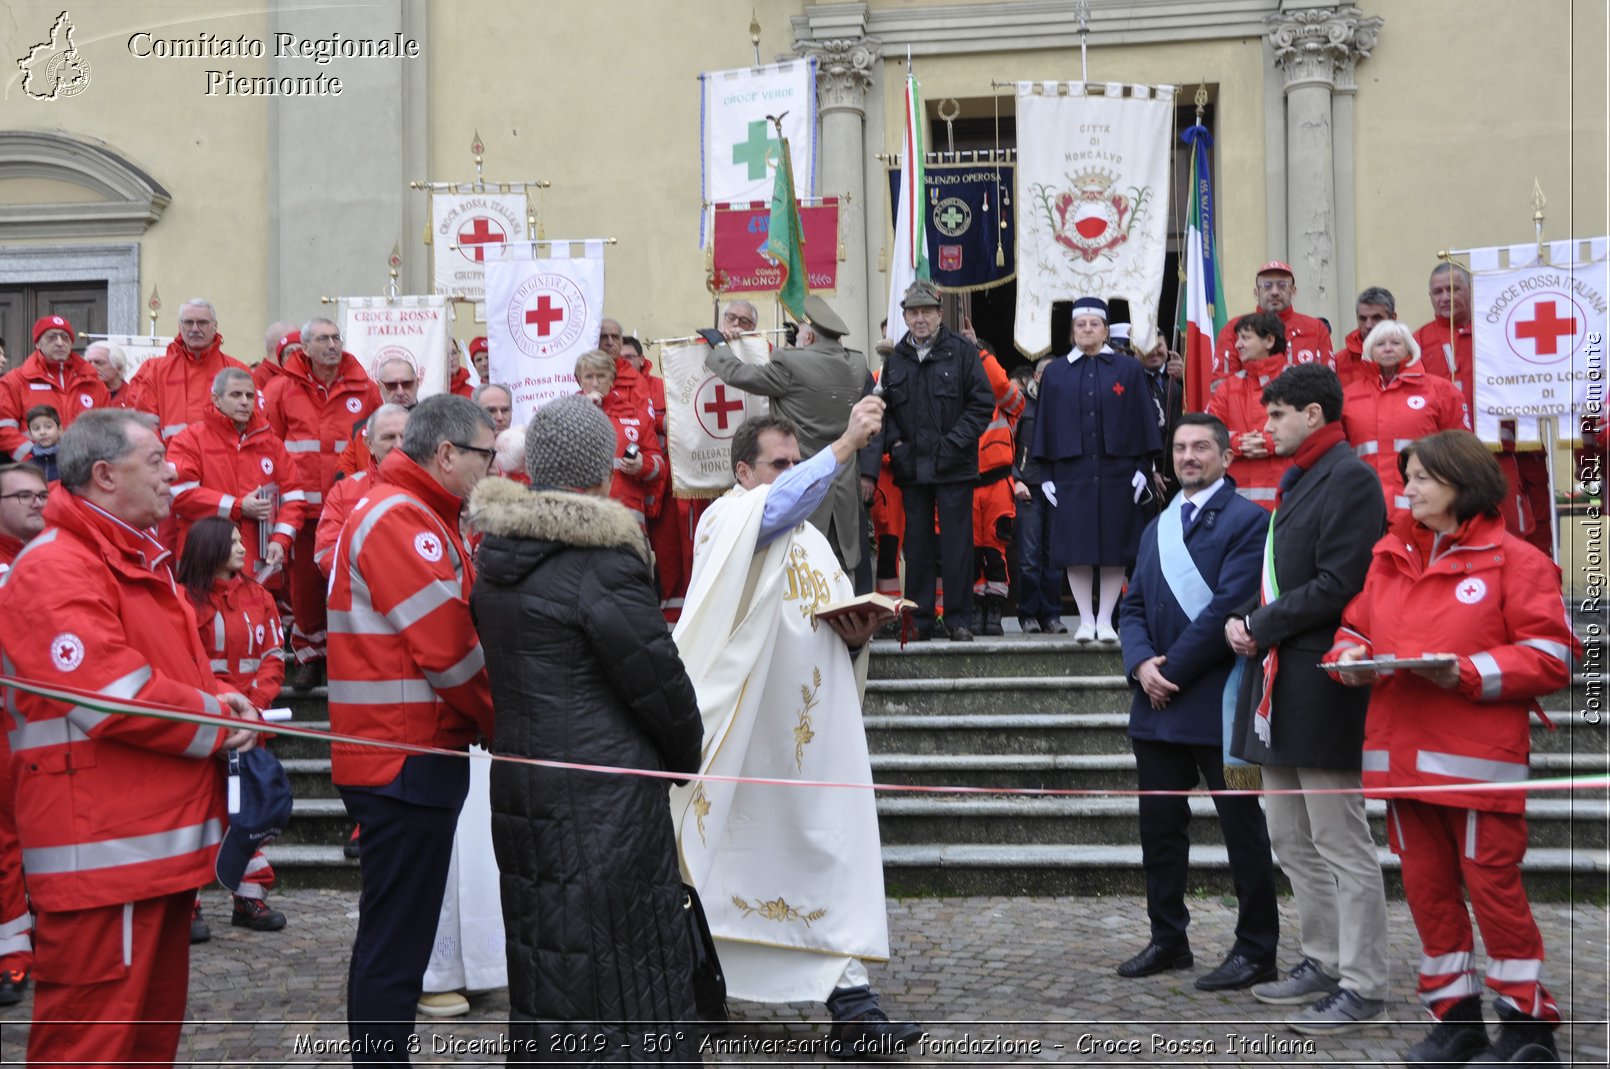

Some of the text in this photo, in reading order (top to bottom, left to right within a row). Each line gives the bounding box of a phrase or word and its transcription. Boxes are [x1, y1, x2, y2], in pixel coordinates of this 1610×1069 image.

[723, 87, 794, 105] CROCE VERDE
[1090, 137, 1100, 146] DI
[1065, 151, 1122, 164] MONCALVO
[924, 172, 1001, 185] SILENZIO OPEROSA
[440, 199, 522, 235] CROCE ROSSA ITALIANA
[1486, 274, 1608, 324] CROCE ROSSA ITALIANA
[354, 310, 439, 322] CROCE ROSSA
[367, 325, 424, 337] ITALIANA
[524, 376, 552, 387] Rossa
[1486, 373, 1553, 385] COMITATO
[680, 374, 700, 406] CROCE
[1541, 388, 1555, 399] DI
[516, 390, 555, 404] COMITATO
[1487, 404, 1565, 416] COCCONATO
